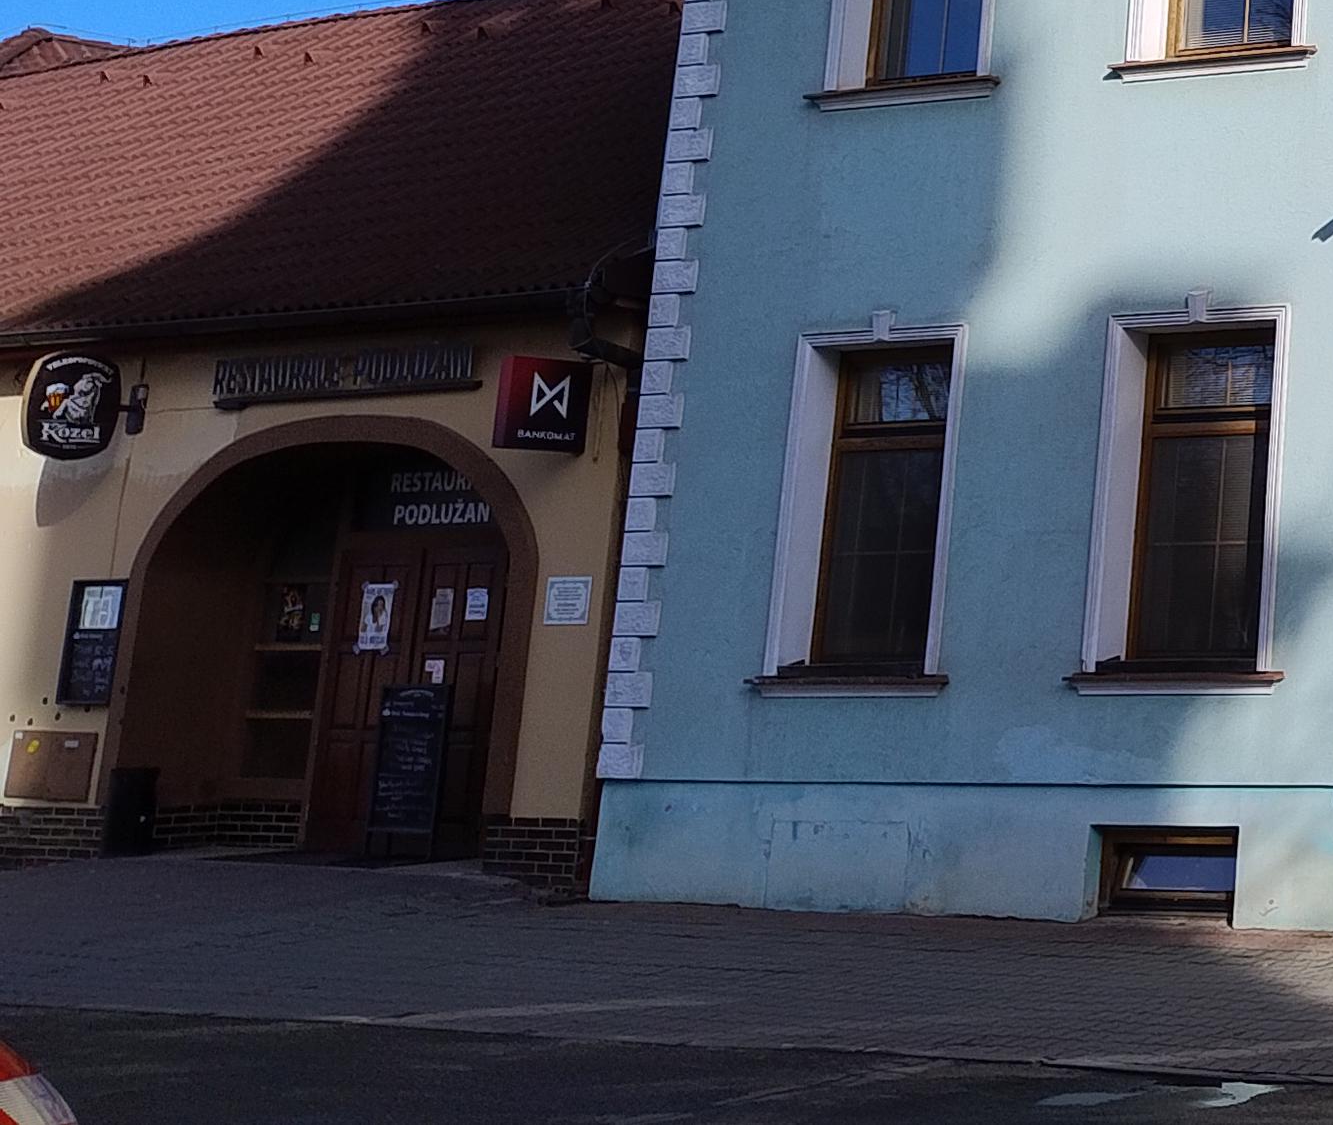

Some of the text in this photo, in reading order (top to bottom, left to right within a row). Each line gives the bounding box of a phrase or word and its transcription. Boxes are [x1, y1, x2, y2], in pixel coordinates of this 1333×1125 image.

[40, 421, 101, 444] Kozel
[517, 428, 577, 441] BANKOMAT
[393, 498, 491, 525] PODLUŽAN
